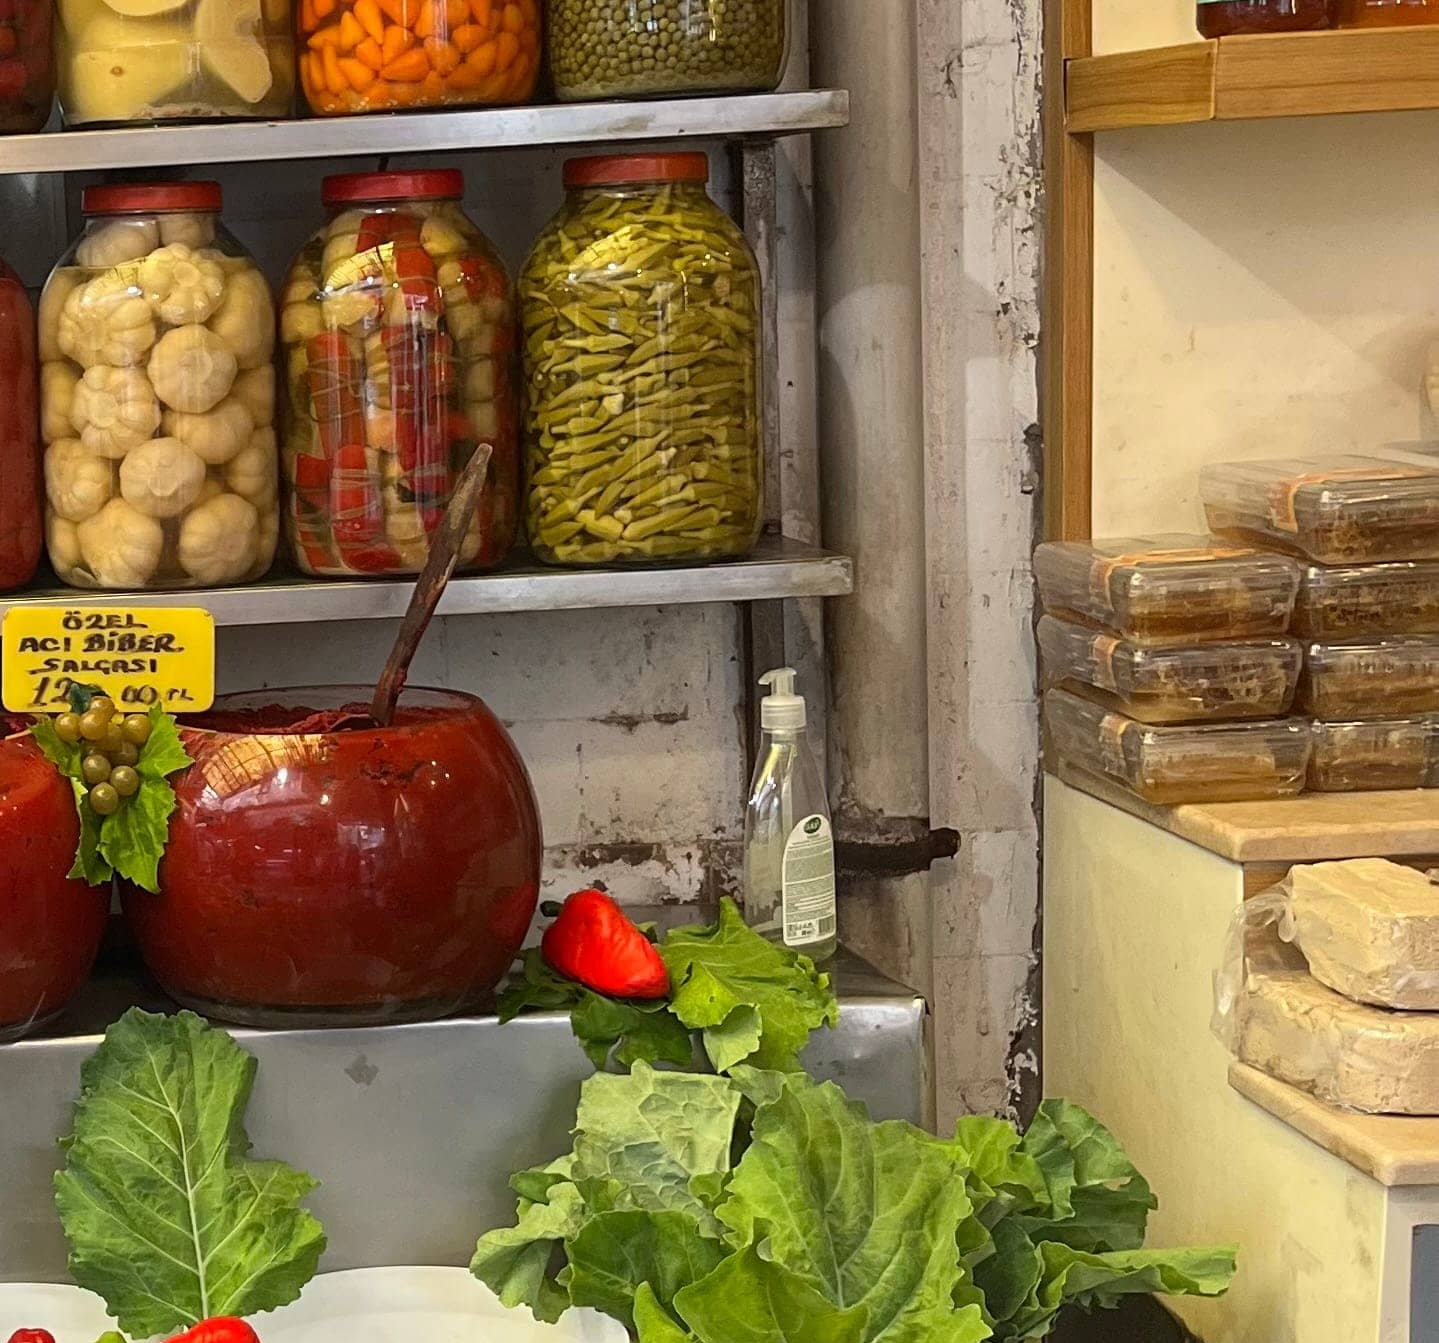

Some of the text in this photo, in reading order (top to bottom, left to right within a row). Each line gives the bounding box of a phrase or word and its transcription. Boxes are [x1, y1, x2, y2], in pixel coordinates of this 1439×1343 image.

[61, 610, 149, 630] ÖZEL
[18, 636, 71, 653] ACI
[167, 687, 195, 702] TL
